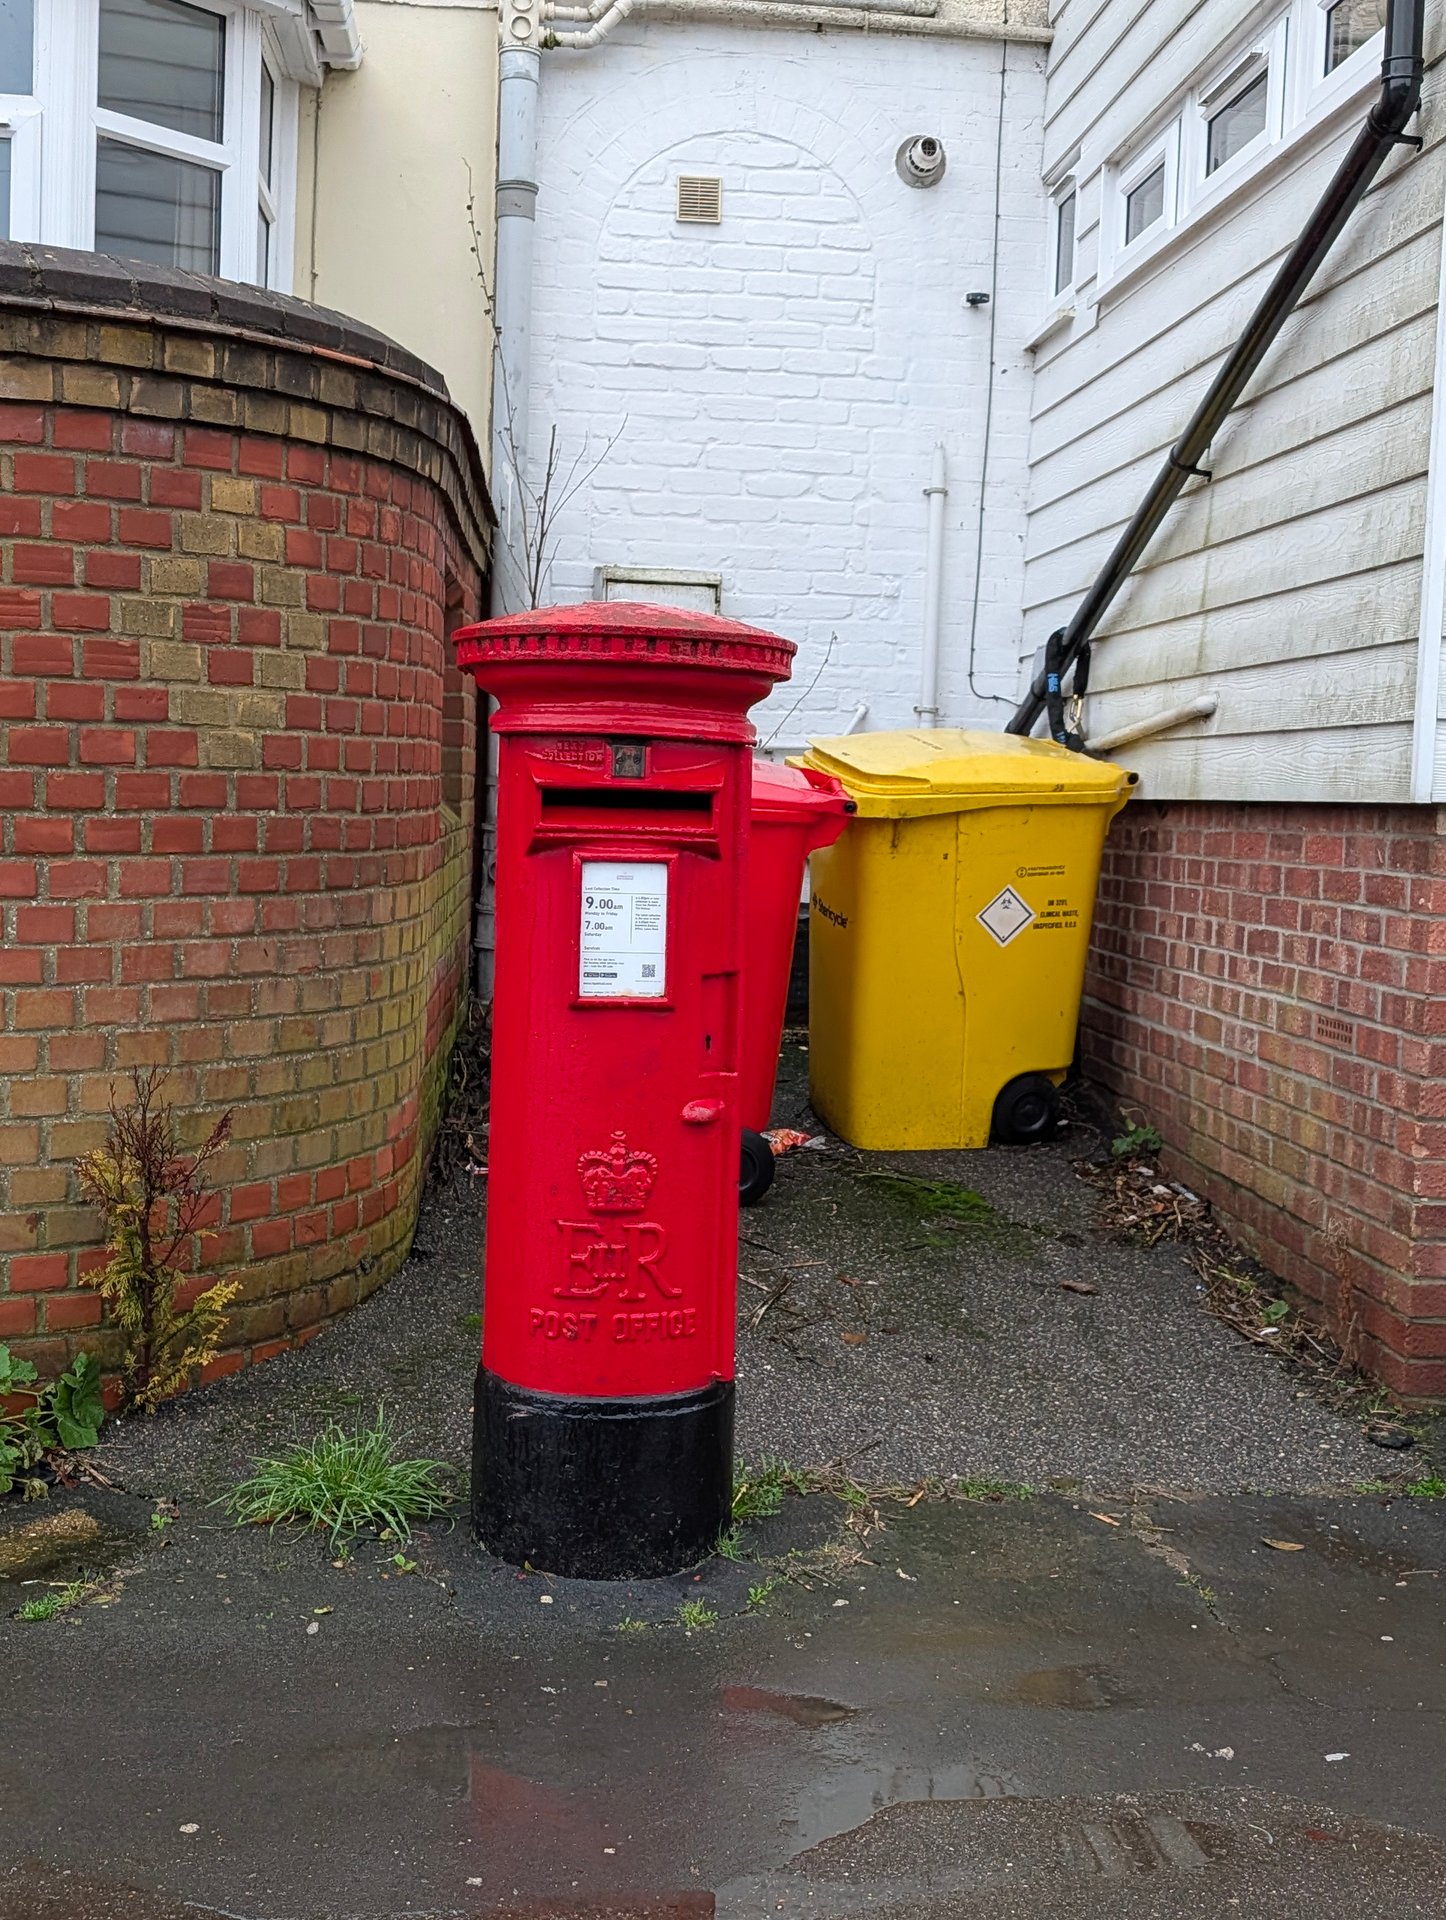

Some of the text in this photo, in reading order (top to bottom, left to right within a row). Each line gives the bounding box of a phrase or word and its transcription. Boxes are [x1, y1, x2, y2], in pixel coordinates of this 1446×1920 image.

[557, 741, 585, 750] NEXT
[543, 751, 603, 761] COLLECTION
[530, 1308, 696, 1342] POST OFFICE
